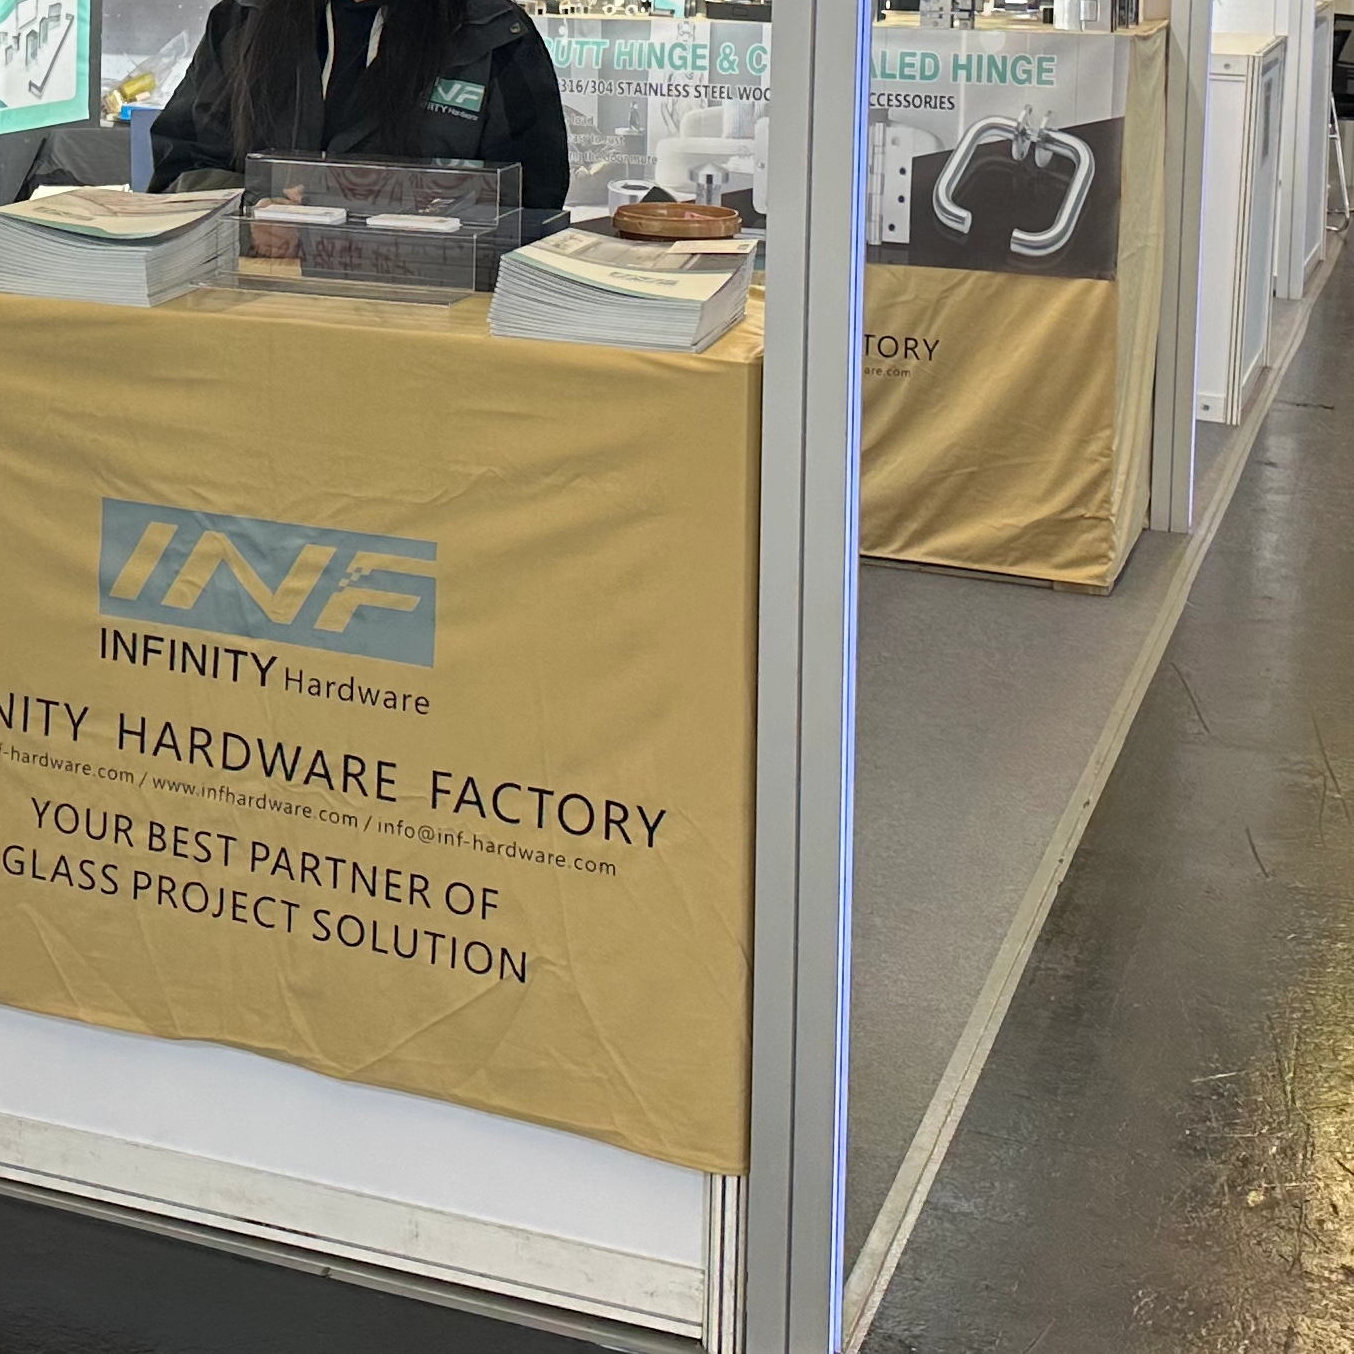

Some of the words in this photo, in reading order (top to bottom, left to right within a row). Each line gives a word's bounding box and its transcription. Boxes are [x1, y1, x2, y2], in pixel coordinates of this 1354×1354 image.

[614, 39, 710, 73] HINGE
[716, 42, 740, 75] &
[617, 81, 690, 98] STAINLESS
[693, 85, 734, 101] STEEL
[951, 52, 1057, 86] HINGE
[863, 333, 940, 361] TORY
[108, 520, 437, 633] INF
[100, 626, 278, 688] INFINITY
[283, 666, 431, 715] Hardware
[118, 712, 397, 803] HARDWARE
[430, 770, 667, 849] FACTORY
[152, 775, 359, 828] www.infhardware.com
[377, 818, 617, 877] info@inf-hardware.com
[30, 796, 135, 848] YOUR
[148, 820, 238, 867] BEST
[249, 841, 431, 909] PARTNER
[444, 881, 499, 921] OF
[2, 844, 120, 895] GLASS
[132, 869, 301, 934] PROJECT
[311, 908, 528, 984] SOLUTION
